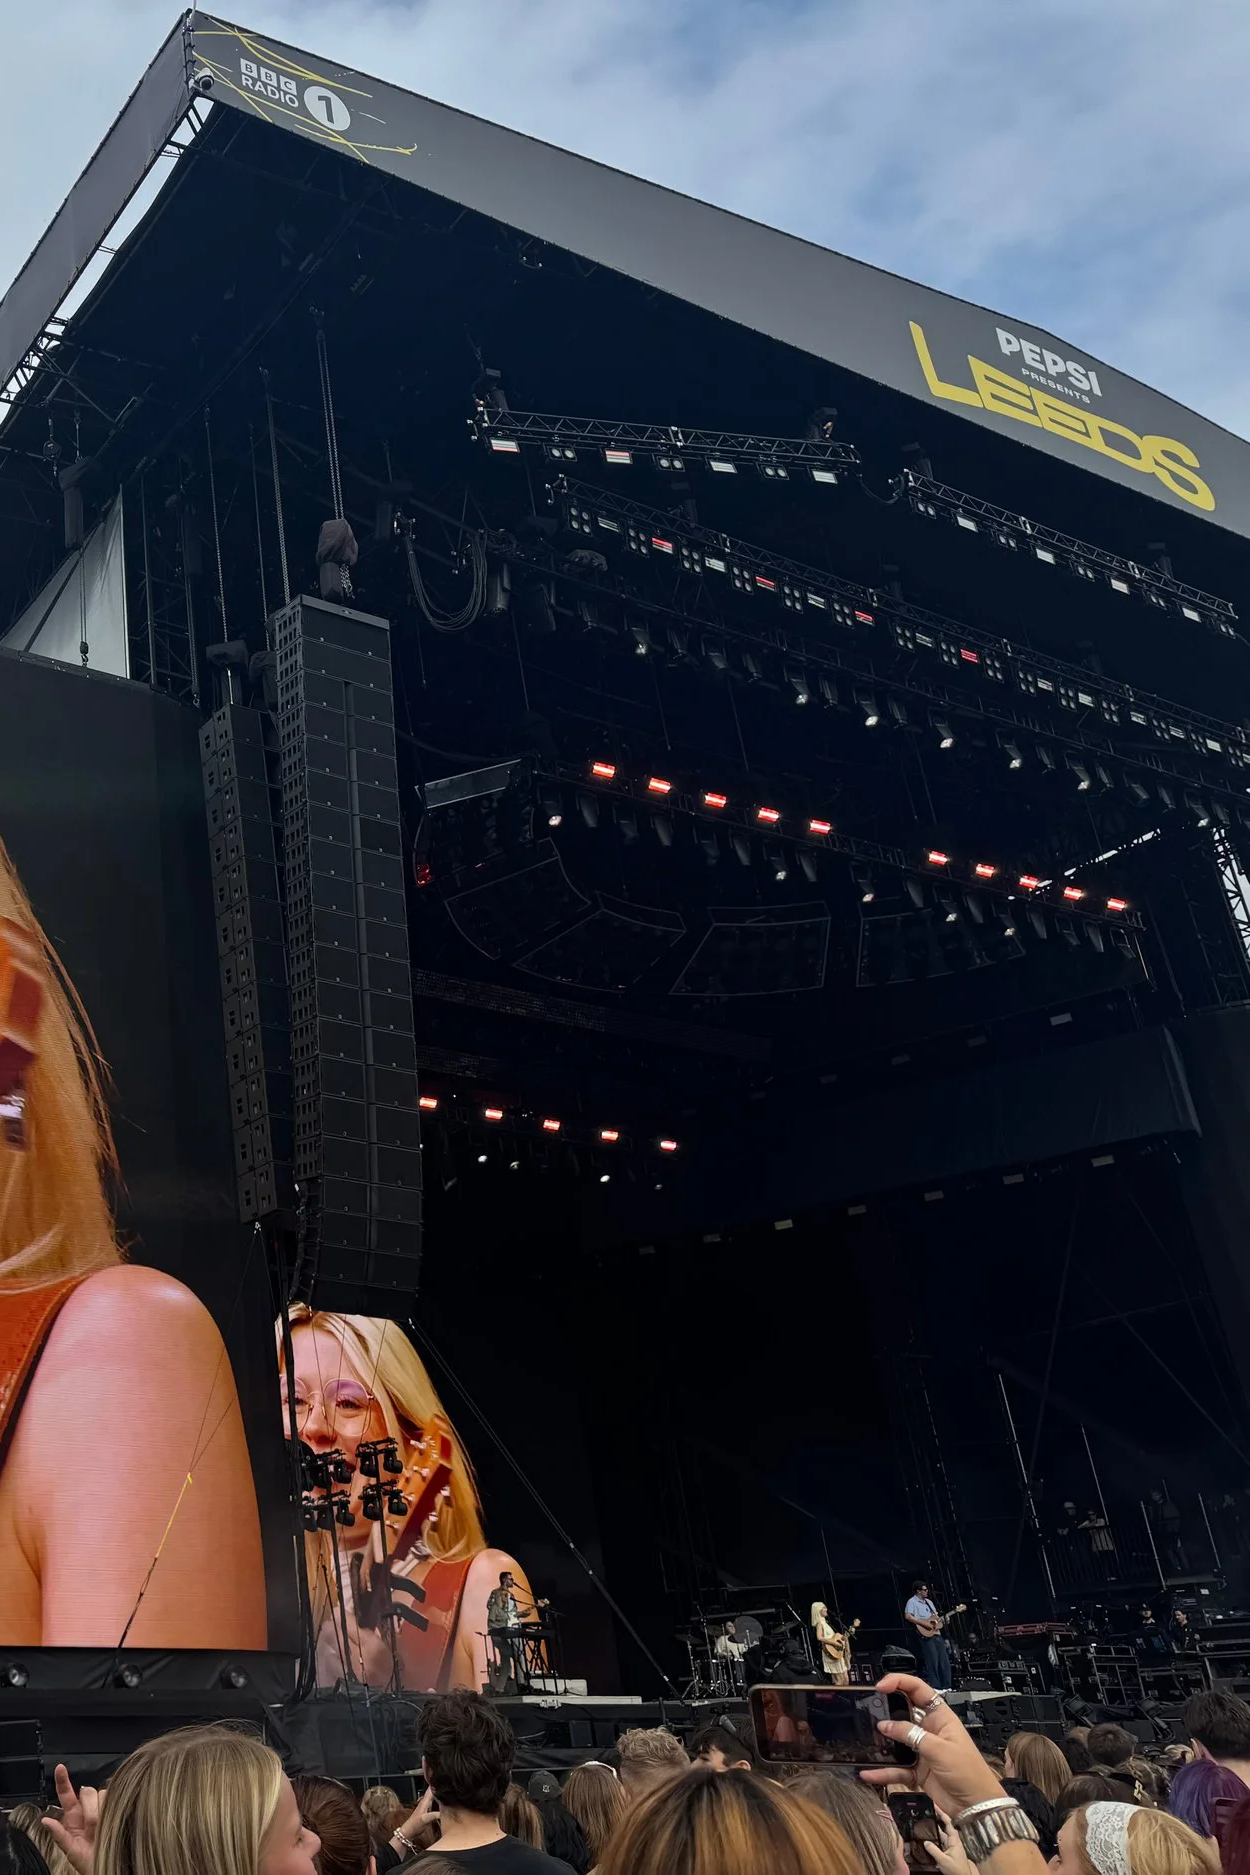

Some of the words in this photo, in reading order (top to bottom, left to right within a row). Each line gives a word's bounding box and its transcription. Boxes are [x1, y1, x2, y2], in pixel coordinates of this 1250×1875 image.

[240, 58, 297, 95] BBC
[241, 74, 299, 108] RADIO
[317, 95, 335, 125] 1
[996, 327, 1102, 397] PEPSI
[1021, 367, 1091, 404] PRESENTS
[909, 320, 1216, 511] LEEDS
